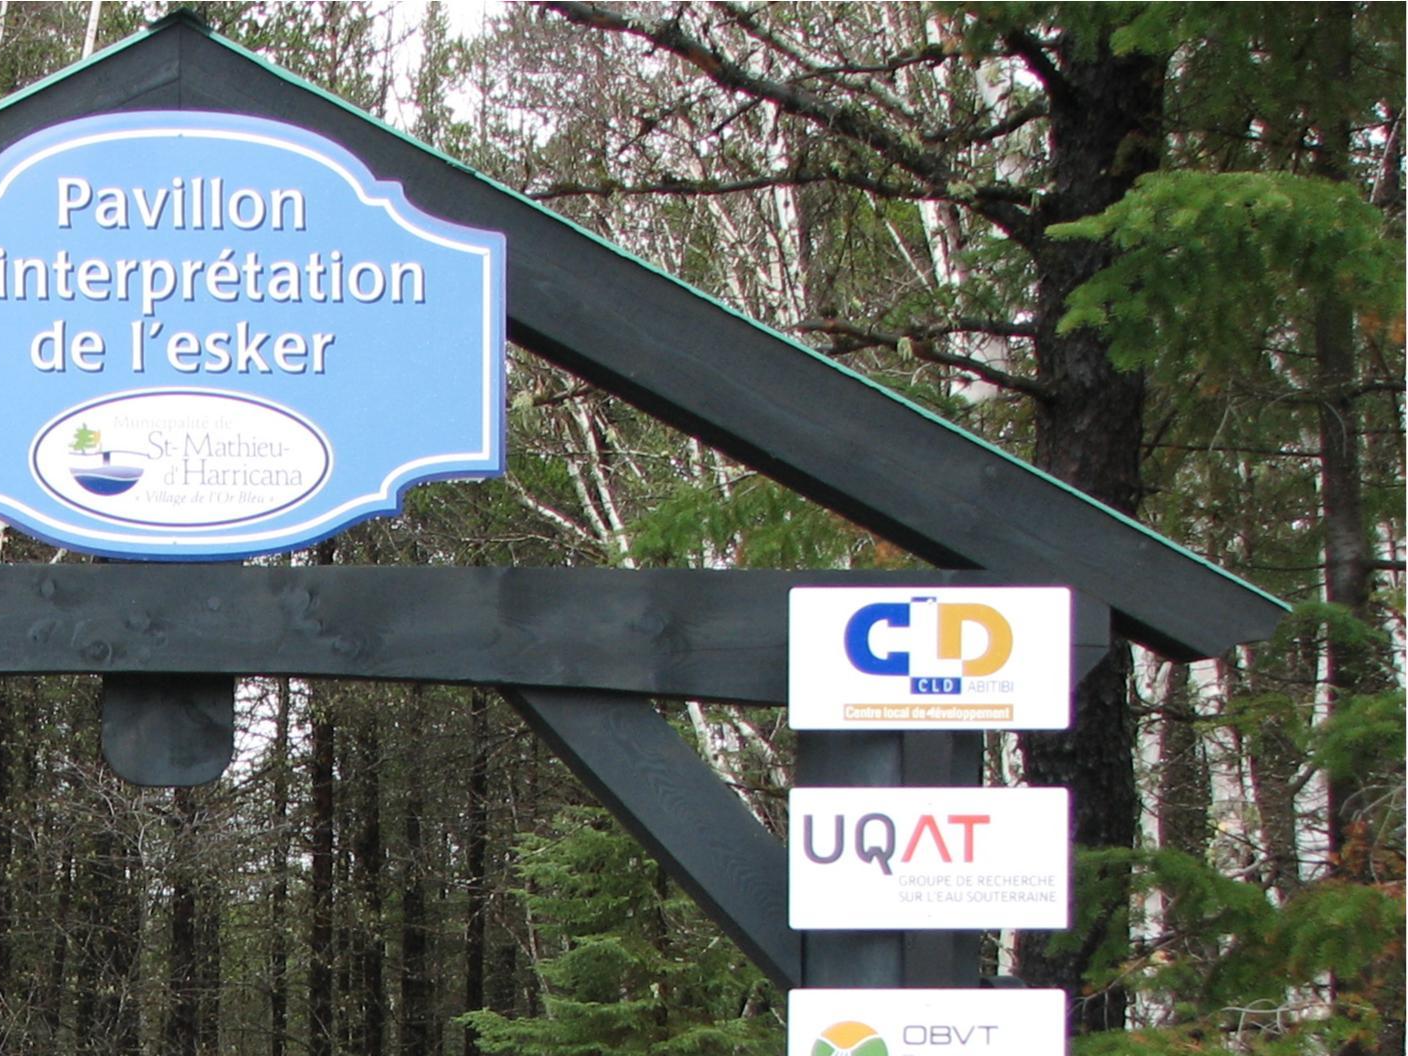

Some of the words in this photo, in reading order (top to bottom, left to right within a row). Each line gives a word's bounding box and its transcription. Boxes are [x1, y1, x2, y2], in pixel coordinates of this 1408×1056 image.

[57, 175, 307, 231] Pavillon
[30, 320, 105, 373] de
[132, 321, 336, 374] l'esker
[918, 678, 954, 692] CLD
[967, 680, 1014, 693] ABITIBI
[845, 706, 882, 719] Centre
[883, 706, 909, 719] local
[912, 706, 926, 719] de
[803, 812, 990, 876] UQAT
[898, 875, 952, 887] GROUPE
[956, 875, 973, 887] DE
[977, 875, 1056, 887] RECHERCHE
[898, 891, 923, 903] SUR
[927, 891, 963, 903] L'EAU
[967, 891, 1057, 903] SOUTERRAINE
[903, 1025, 999, 1045] OBVT
